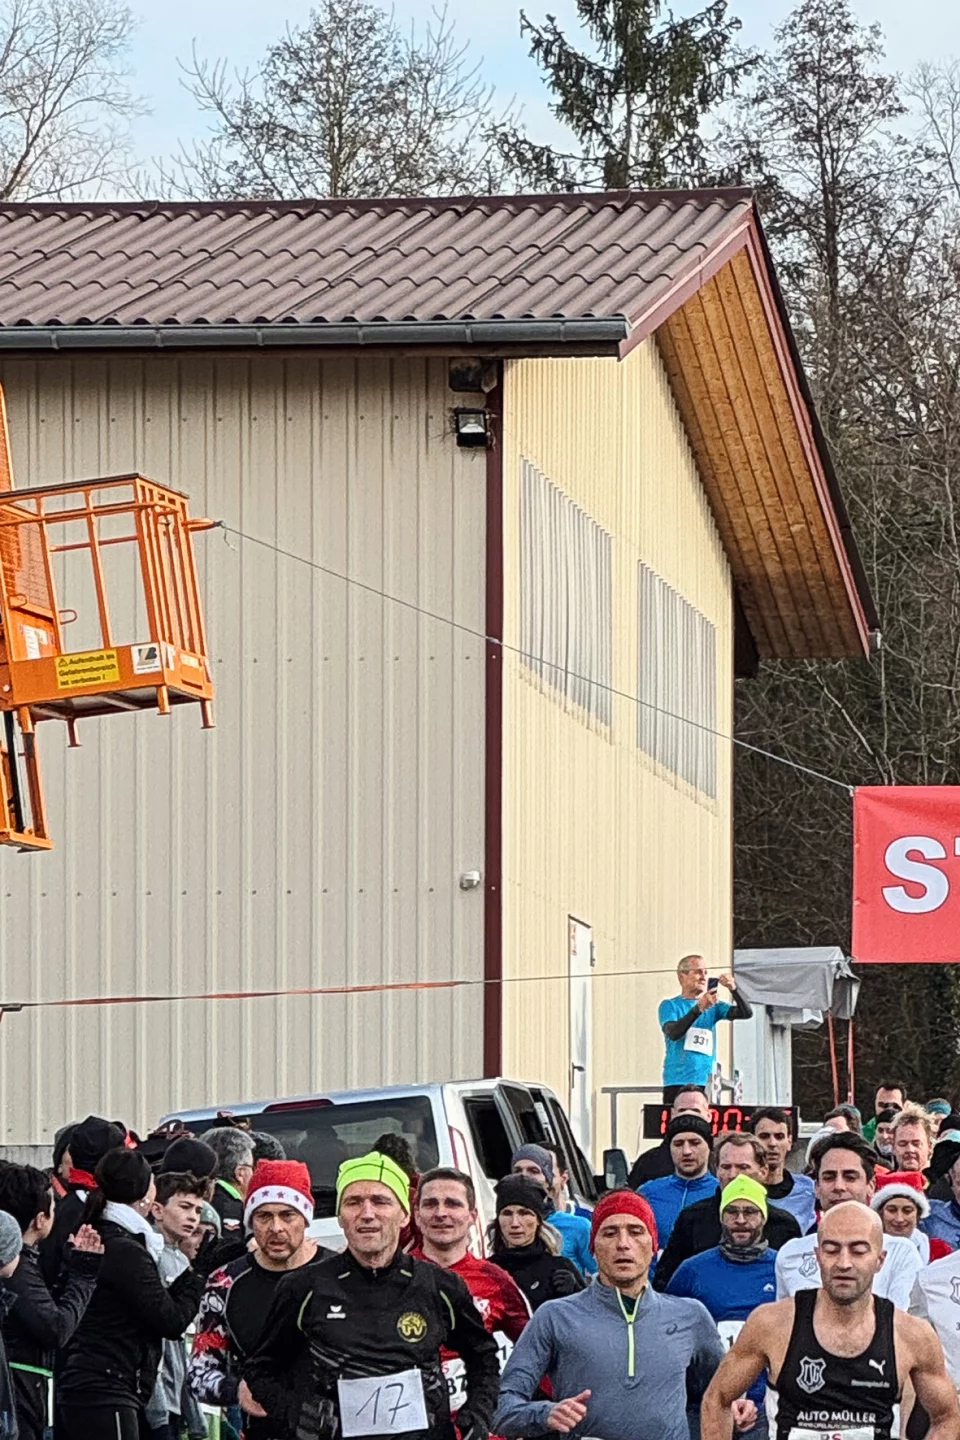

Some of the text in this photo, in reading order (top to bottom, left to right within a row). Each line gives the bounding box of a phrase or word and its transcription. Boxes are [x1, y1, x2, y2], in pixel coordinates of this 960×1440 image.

[355, 1382, 411, 1425] 17
[796, 1409, 877, 1424] AUTO MÜLLER
